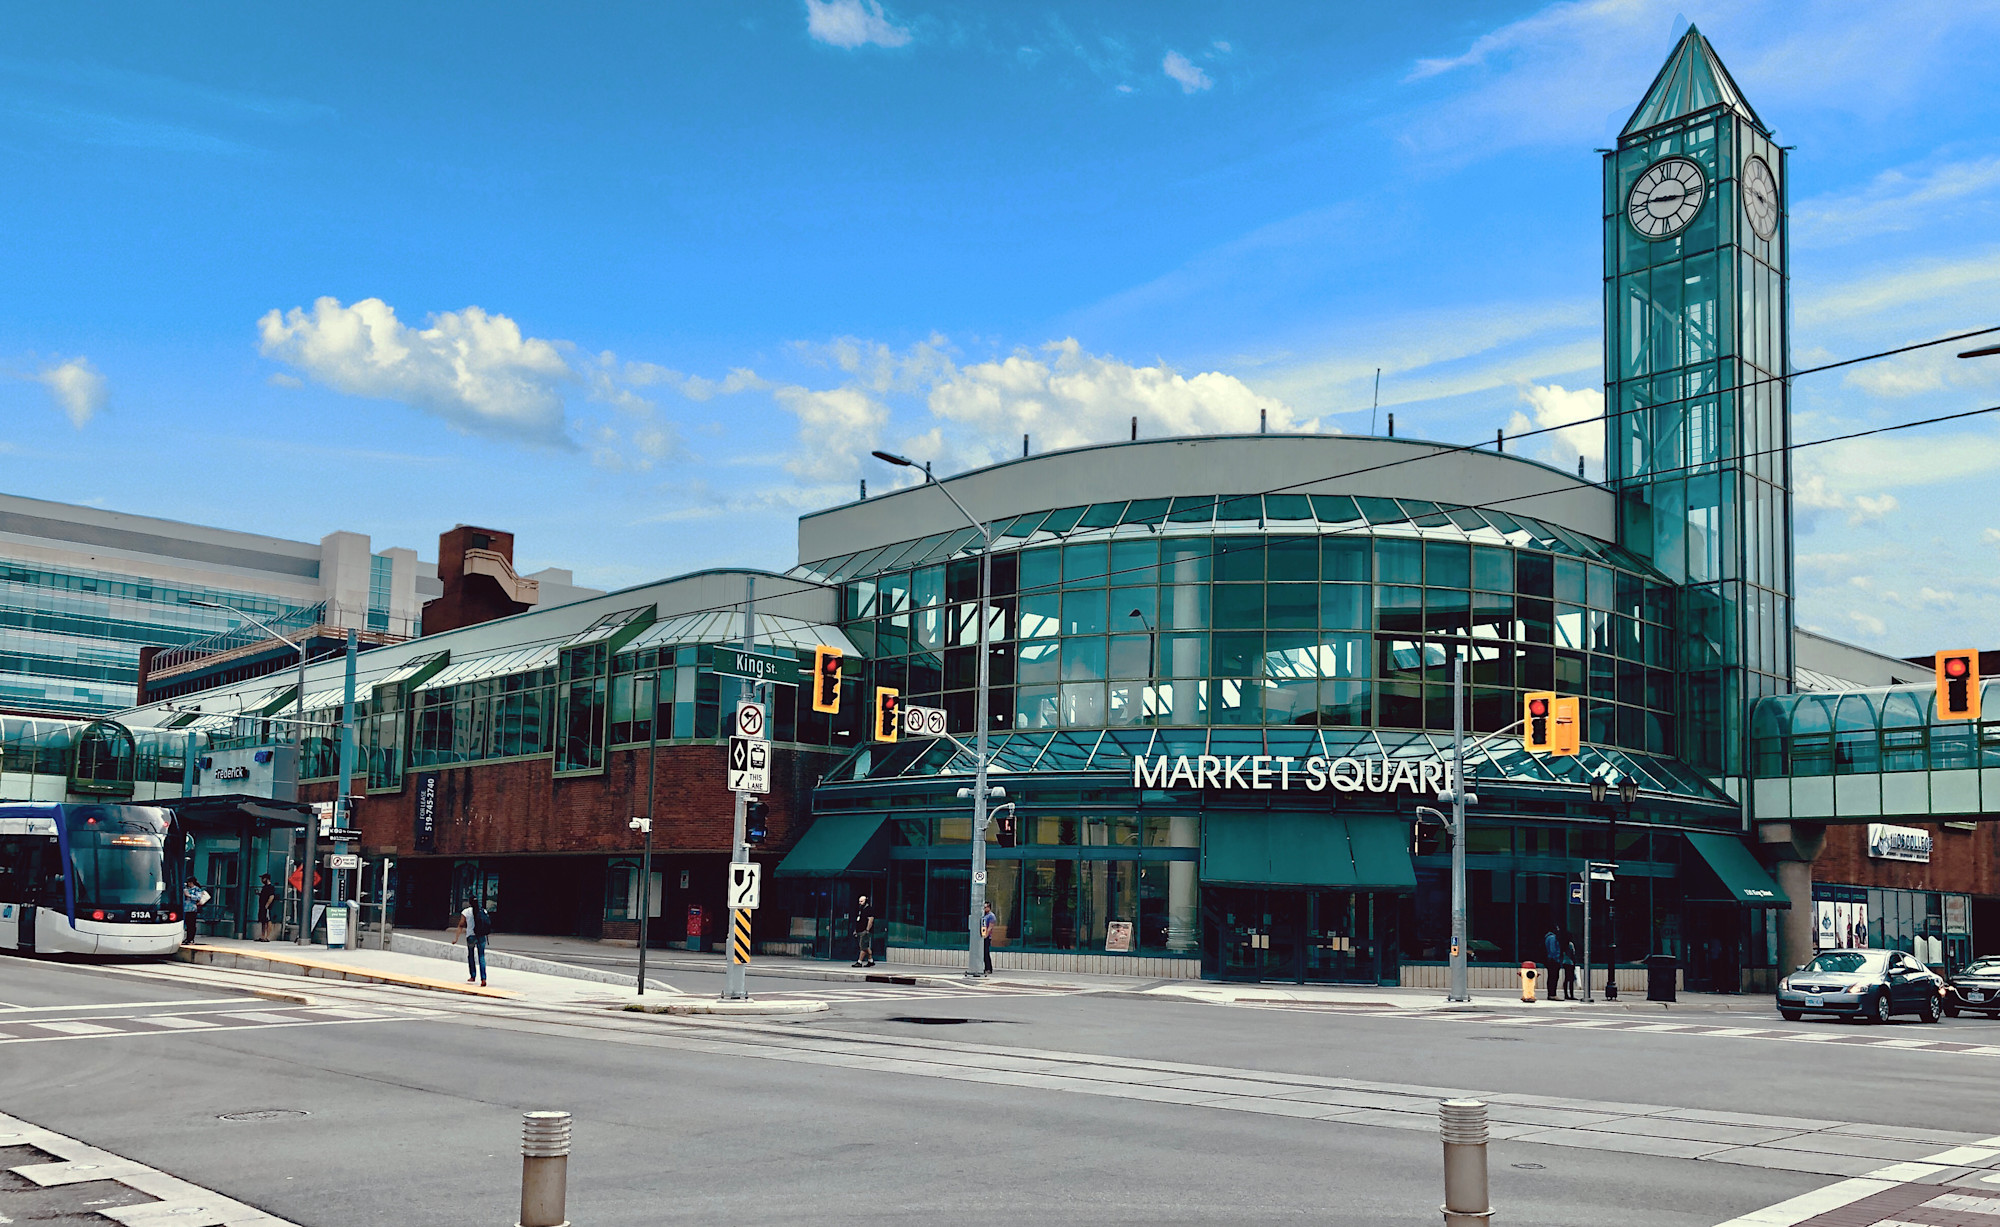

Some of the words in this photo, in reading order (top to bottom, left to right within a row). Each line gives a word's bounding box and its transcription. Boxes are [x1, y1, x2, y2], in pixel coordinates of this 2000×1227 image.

[736, 653, 764, 679] King
[765, 662, 778, 675] St.
[214, 766, 246, 779] Frederick
[749, 773, 763, 781] THIS
[1134, 755, 1294, 791] MARKET
[747, 782, 764, 790] LANE
[425, 778, 435, 831] 519-745-2740
[130, 911, 151, 919] 513A
